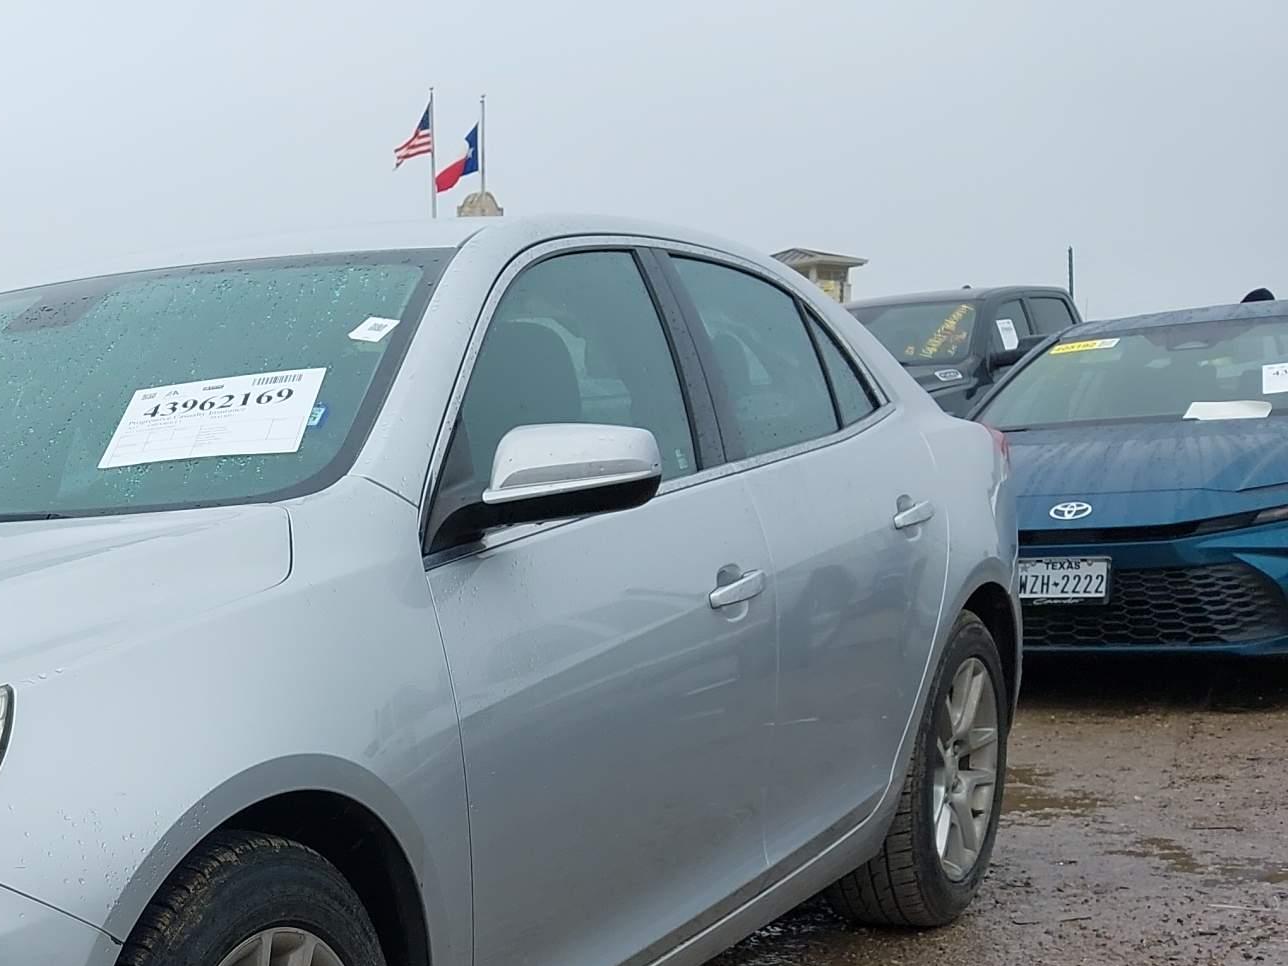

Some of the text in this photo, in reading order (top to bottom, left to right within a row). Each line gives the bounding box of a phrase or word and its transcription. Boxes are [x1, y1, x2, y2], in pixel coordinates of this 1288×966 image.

[143, 387, 294, 418] 43962169
[1044, 560, 1081, 571] TEXAS
[1018, 574, 1105, 595] WZH-2222
